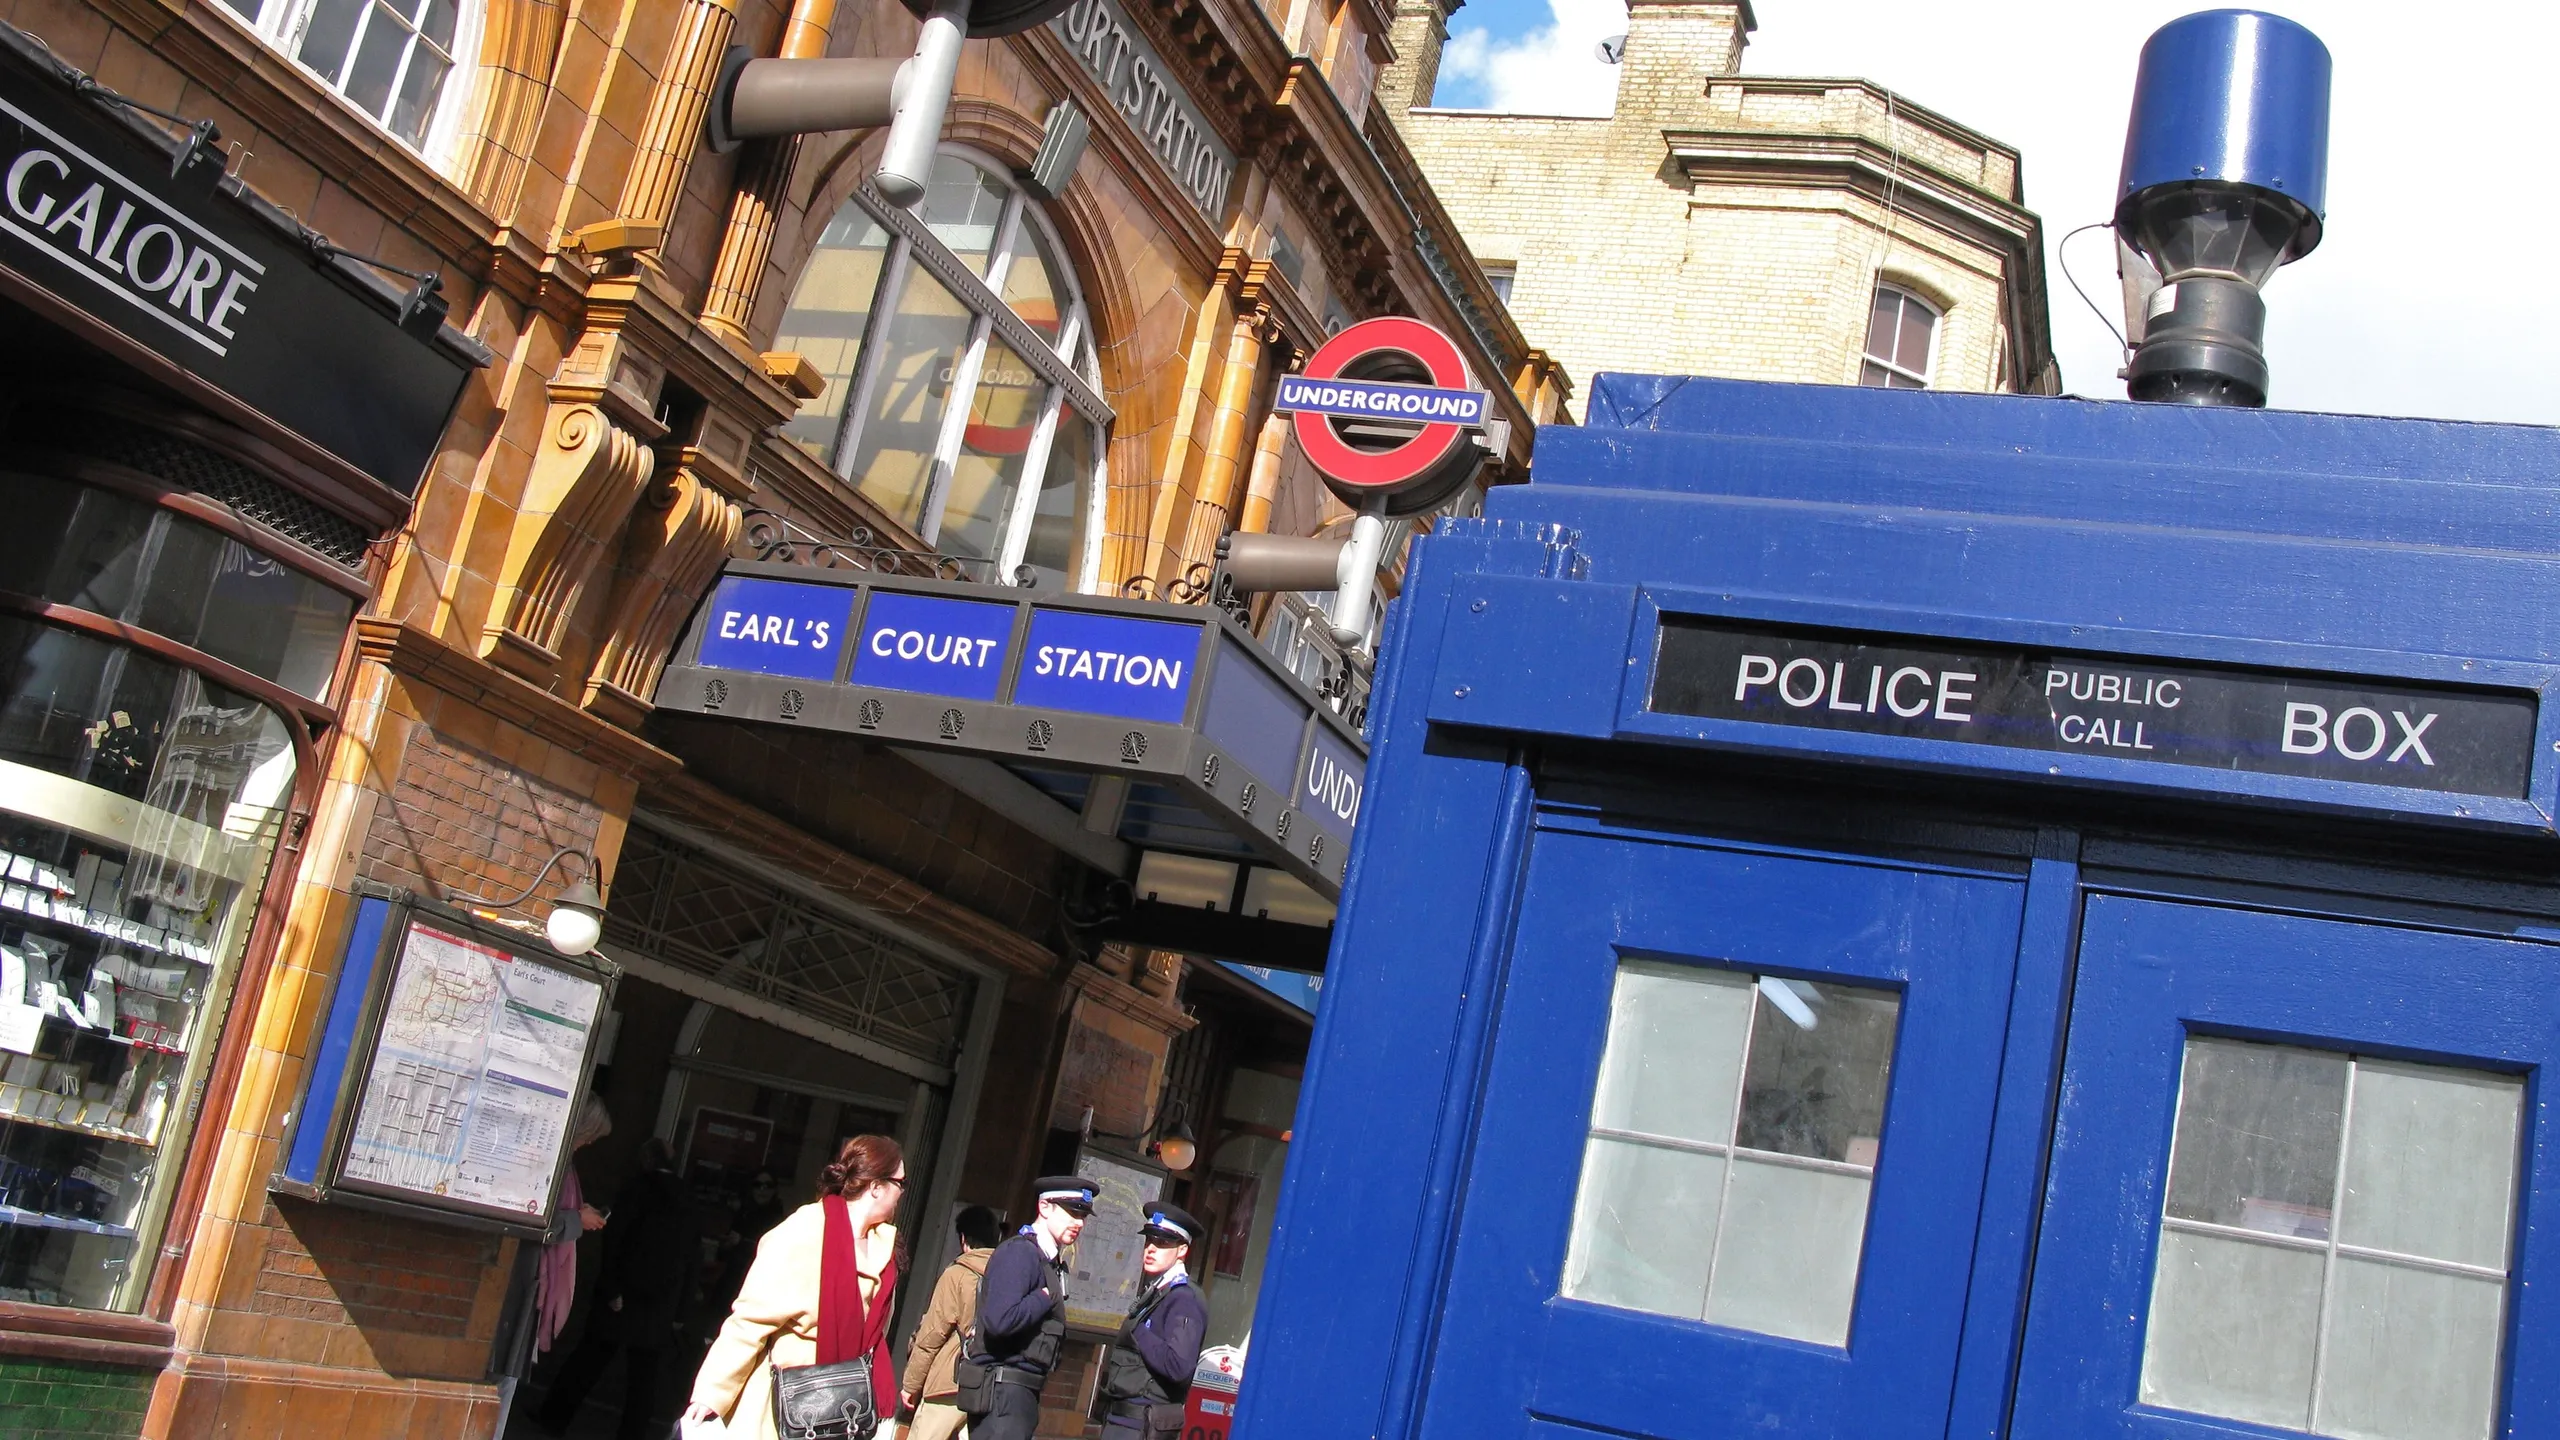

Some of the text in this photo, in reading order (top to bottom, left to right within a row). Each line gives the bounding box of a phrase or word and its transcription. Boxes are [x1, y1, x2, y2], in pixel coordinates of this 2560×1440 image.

[1056, 0, 1232, 224] URT STATION
[6, 149, 259, 340] GALORE
[1282, 384, 1478, 419] UNDERGROUND
[719, 611, 1182, 690] EARL'S COURT STATION
[1734, 654, 1978, 722] POLICE
[2044, 669, 2182, 709] PUBLIC
[2059, 714, 2154, 750] CALL
[2281, 701, 2439, 767] BOX
[513, 967, 546, 986] Earl's Court
